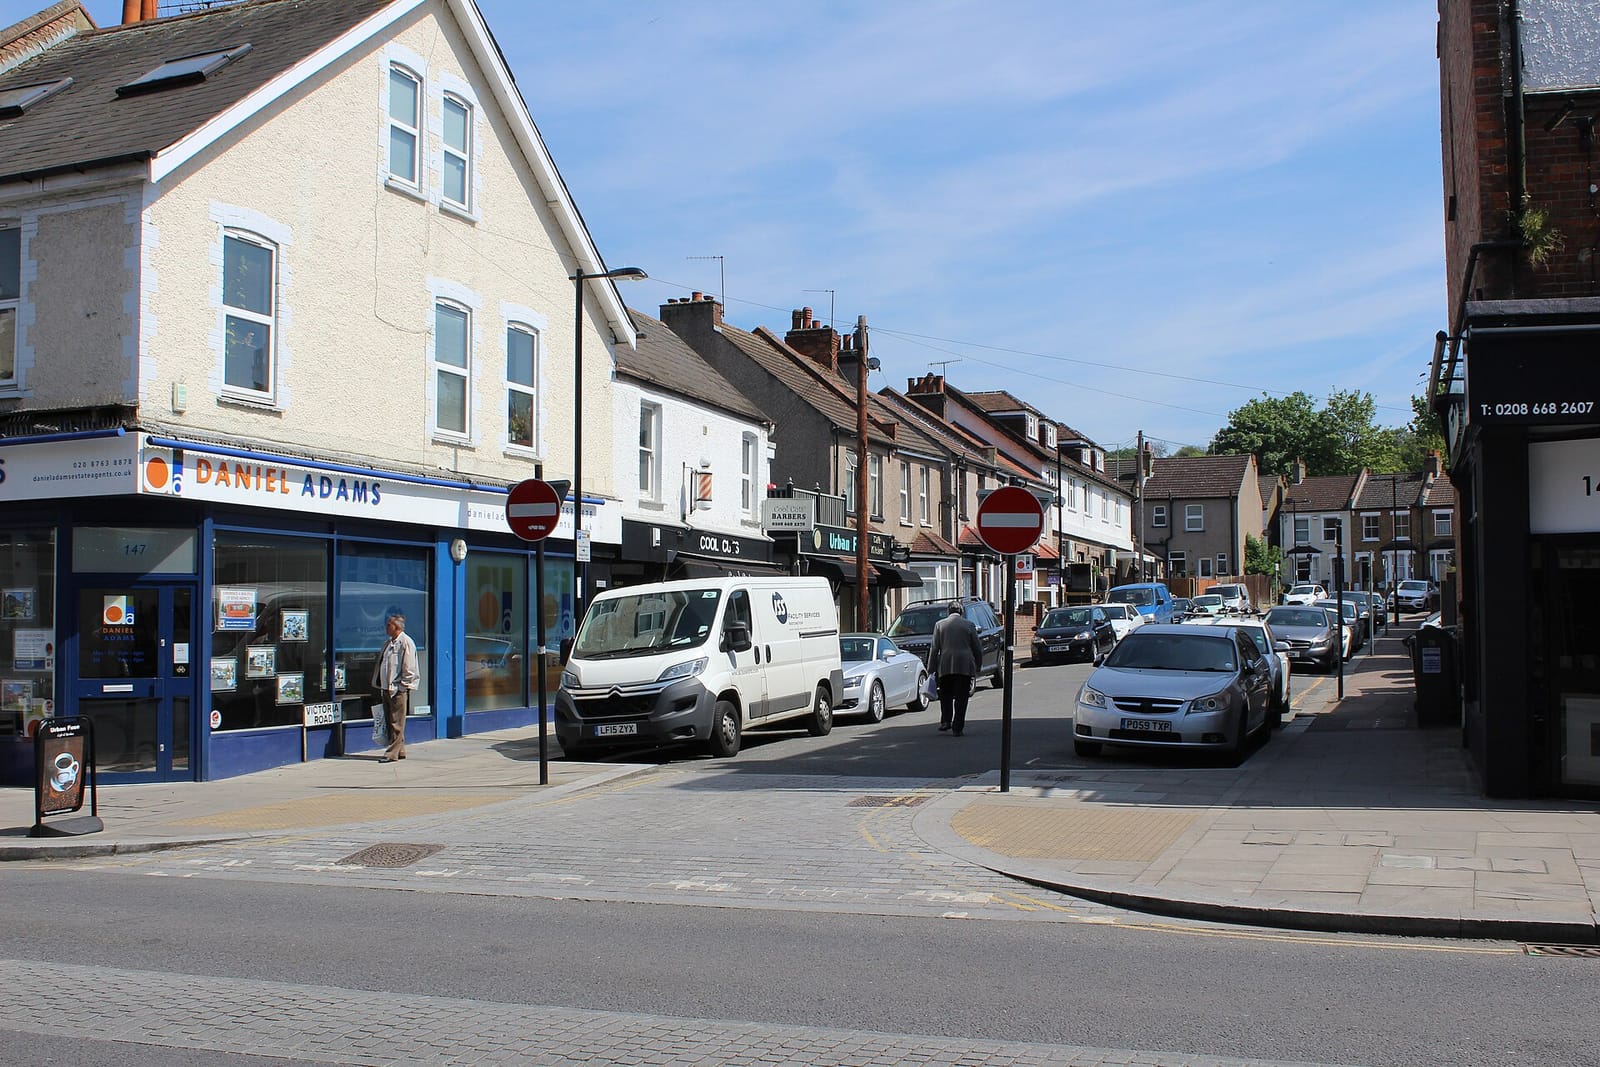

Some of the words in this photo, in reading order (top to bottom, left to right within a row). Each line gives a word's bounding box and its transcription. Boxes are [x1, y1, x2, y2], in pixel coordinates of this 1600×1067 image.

[1480, 404, 1492, 416] T:
[1495, 403, 1529, 416] 0208
[1532, 402, 1557, 415] 668
[1560, 401, 1594, 414] 2607
[196, 458, 290, 494] DANIEL
[301, 473, 382, 505] ADAMS
[700, 535, 719, 552] COOL
[829, 532, 850, 552] Urban
[125, 544, 146, 556] 147
[306, 703, 339, 716] VICTORIA
[314, 714, 333, 724] ROAD
[600, 725, 618, 735] LF15
[619, 724, 634, 734] ZYX
[1152, 721, 1170, 731] TXP
